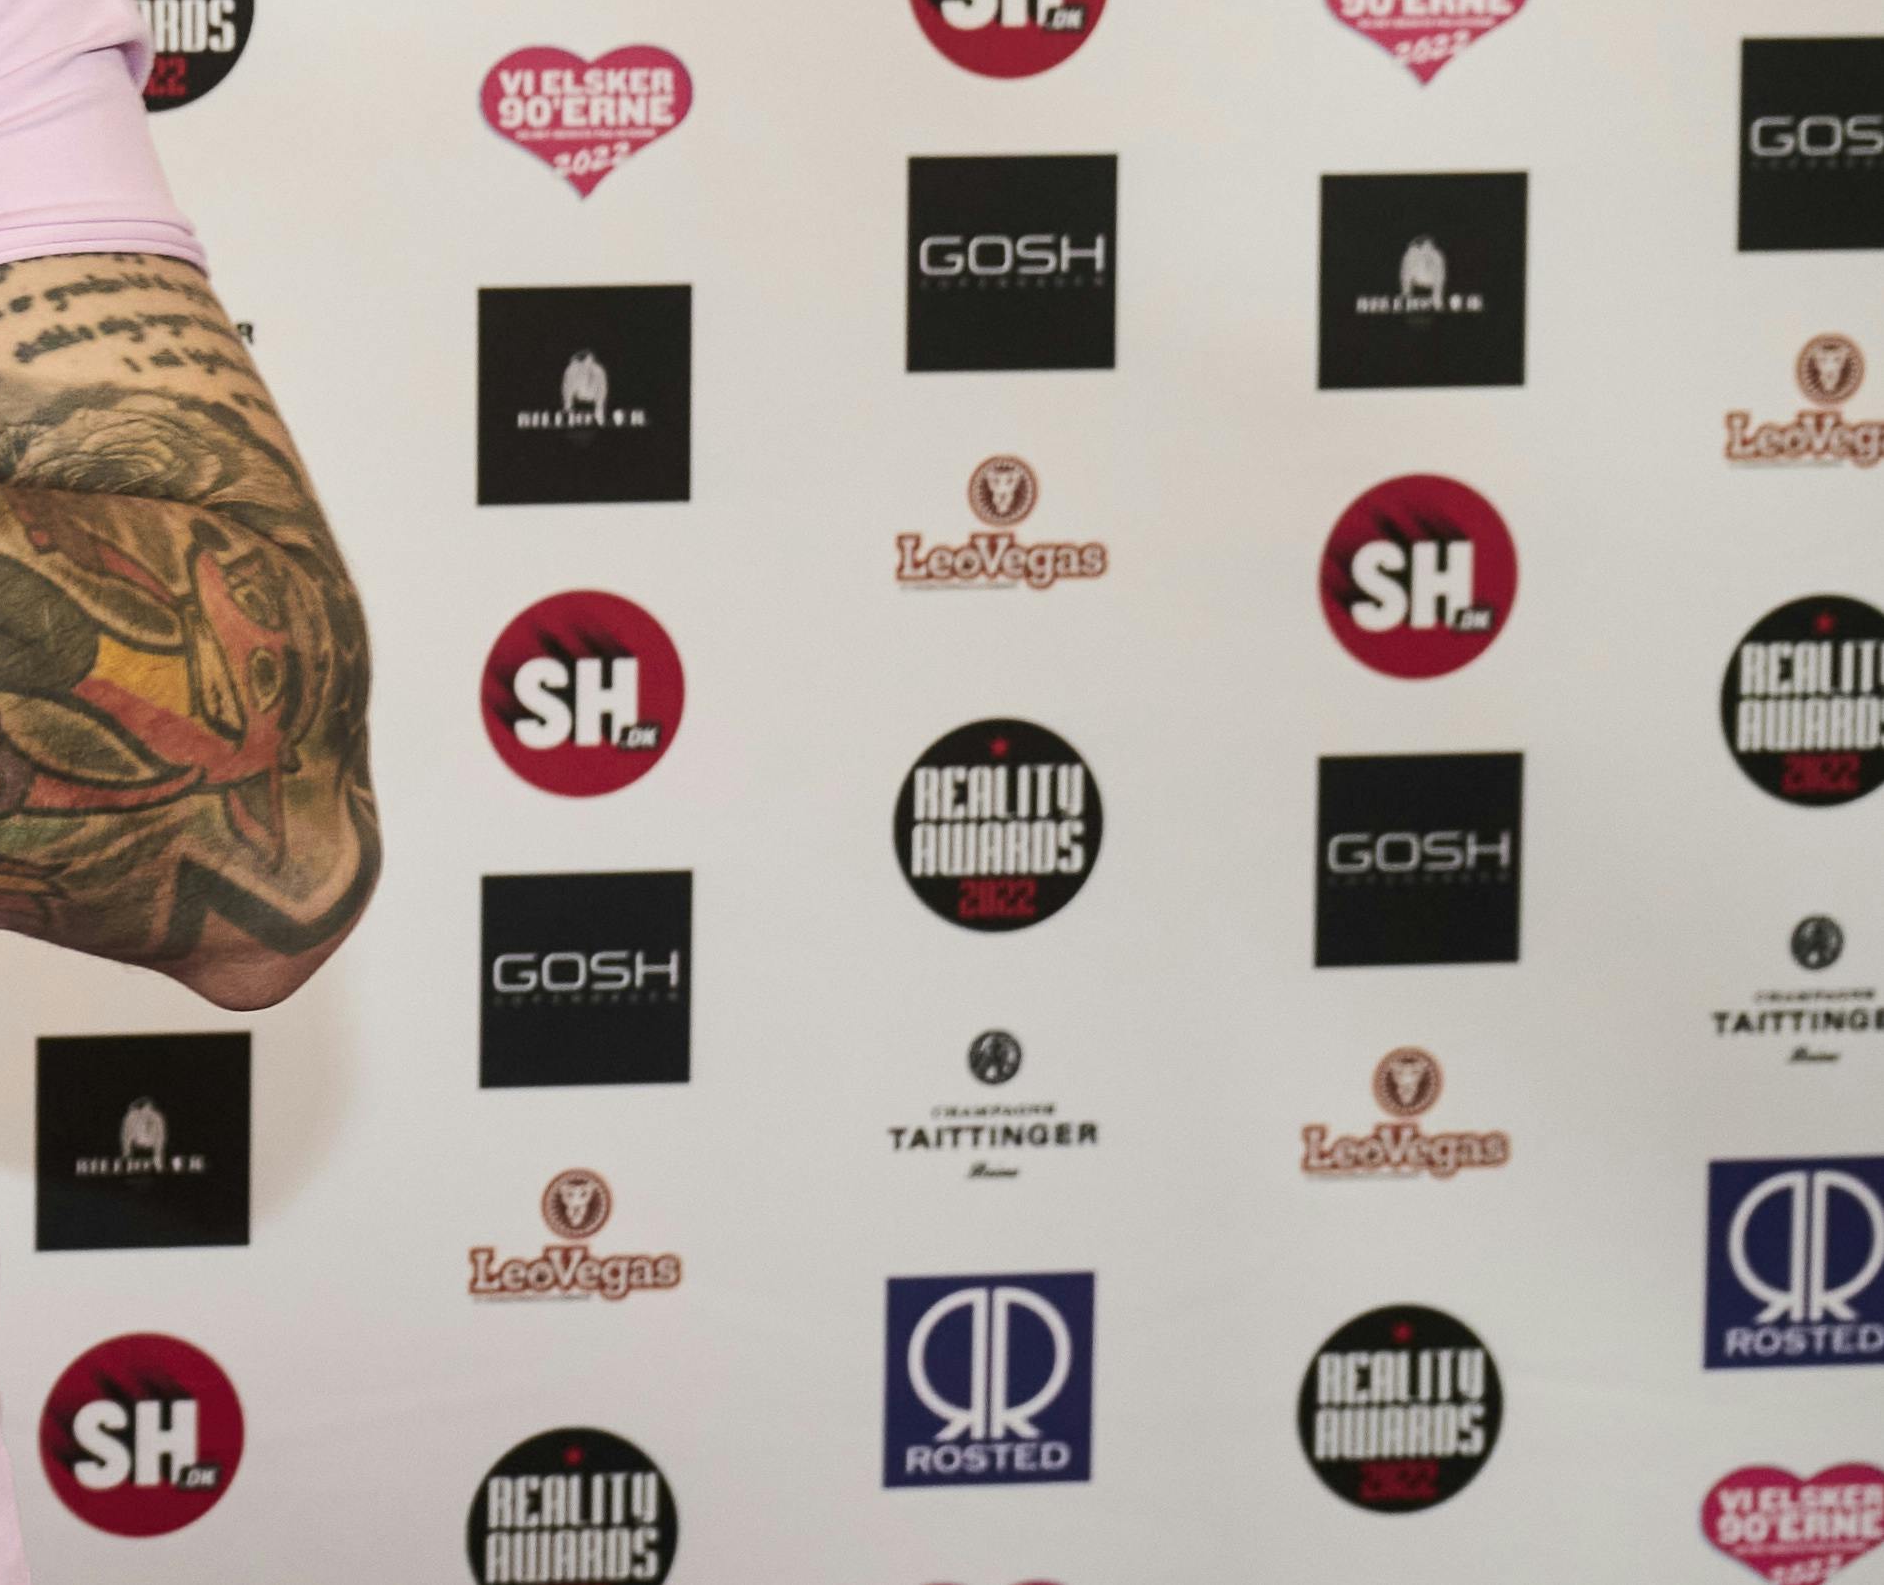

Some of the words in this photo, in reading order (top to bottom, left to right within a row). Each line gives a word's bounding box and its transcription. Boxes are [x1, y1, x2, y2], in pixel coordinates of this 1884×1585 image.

[144, 56, 187, 96] 22
[499, 70, 538, 96] VI
[541, 68, 674, 96] ELSKER
[498, 97, 674, 130] 90'ERNE
[1750, 115, 1884, 157] GOS
[554, 141, 630, 175] 2022
[919, 235, 1105, 276] GOSH
[894, 533, 1106, 584] LeoVegas
[913, 764, 1083, 819] REALITY
[911, 820, 1084, 876] AWARDS
[1327, 831, 1511, 873] GOSH
[958, 879, 1033, 912] 2022
[492, 951, 679, 992] GOSH
[890, 1122, 1098, 1149] TAITTINGER
[1303, 1125, 1513, 1179] LeoVegas
[467, 1247, 683, 1301] LeoVegas
[1725, 1324, 1884, 1355] ROSTED
[1318, 1349, 1483, 1404] REALITY
[1318, 1405, 1485, 1459] AWARDS
[905, 1443, 1070, 1473] ROSTED
[487, 1470, 655, 1530] REALITY
[486, 1527, 658, 1583] AWARDS
